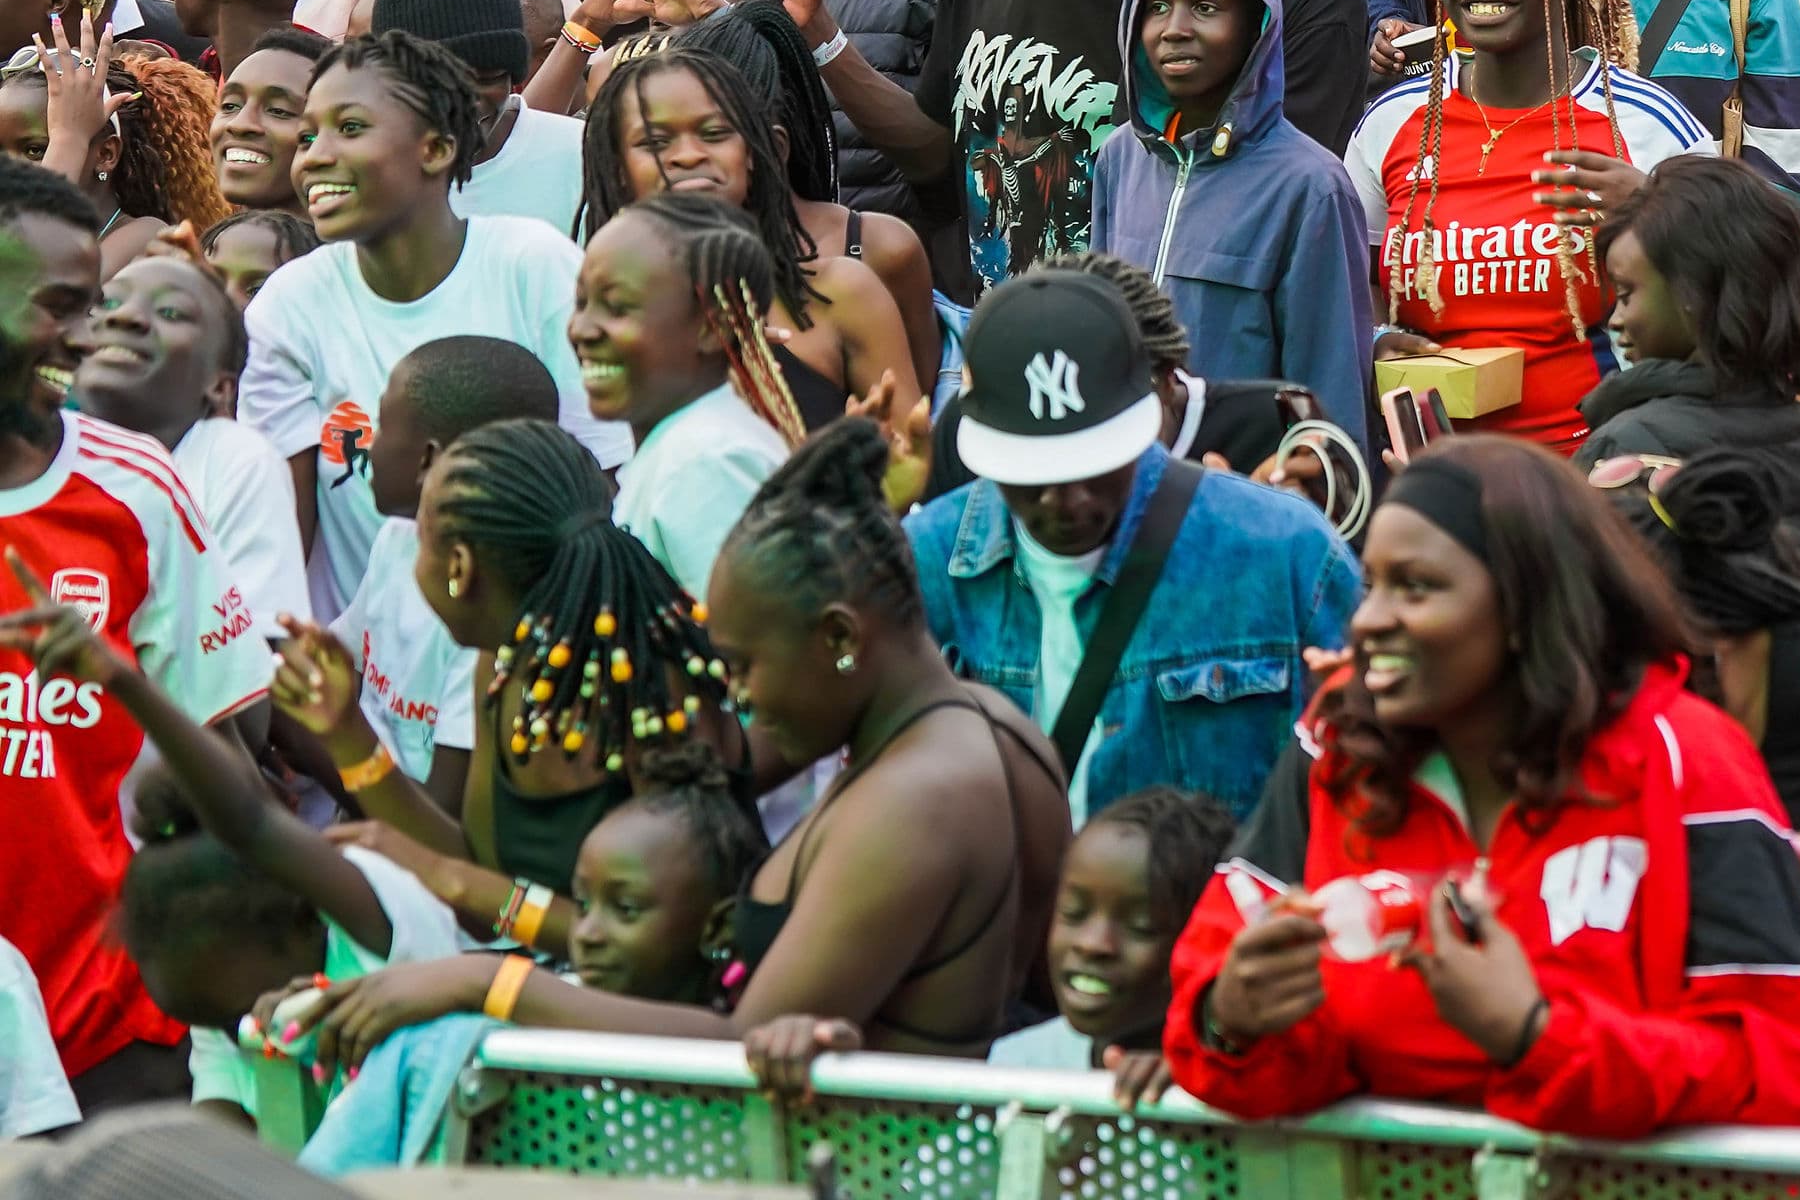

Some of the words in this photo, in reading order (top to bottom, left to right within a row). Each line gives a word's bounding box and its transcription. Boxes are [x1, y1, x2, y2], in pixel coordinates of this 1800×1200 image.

[1454, 258, 1551, 296] BETTER
[1024, 348, 1086, 421] NY
[61, 582, 101, 598] Arsenal
[1539, 834, 1650, 948] W
